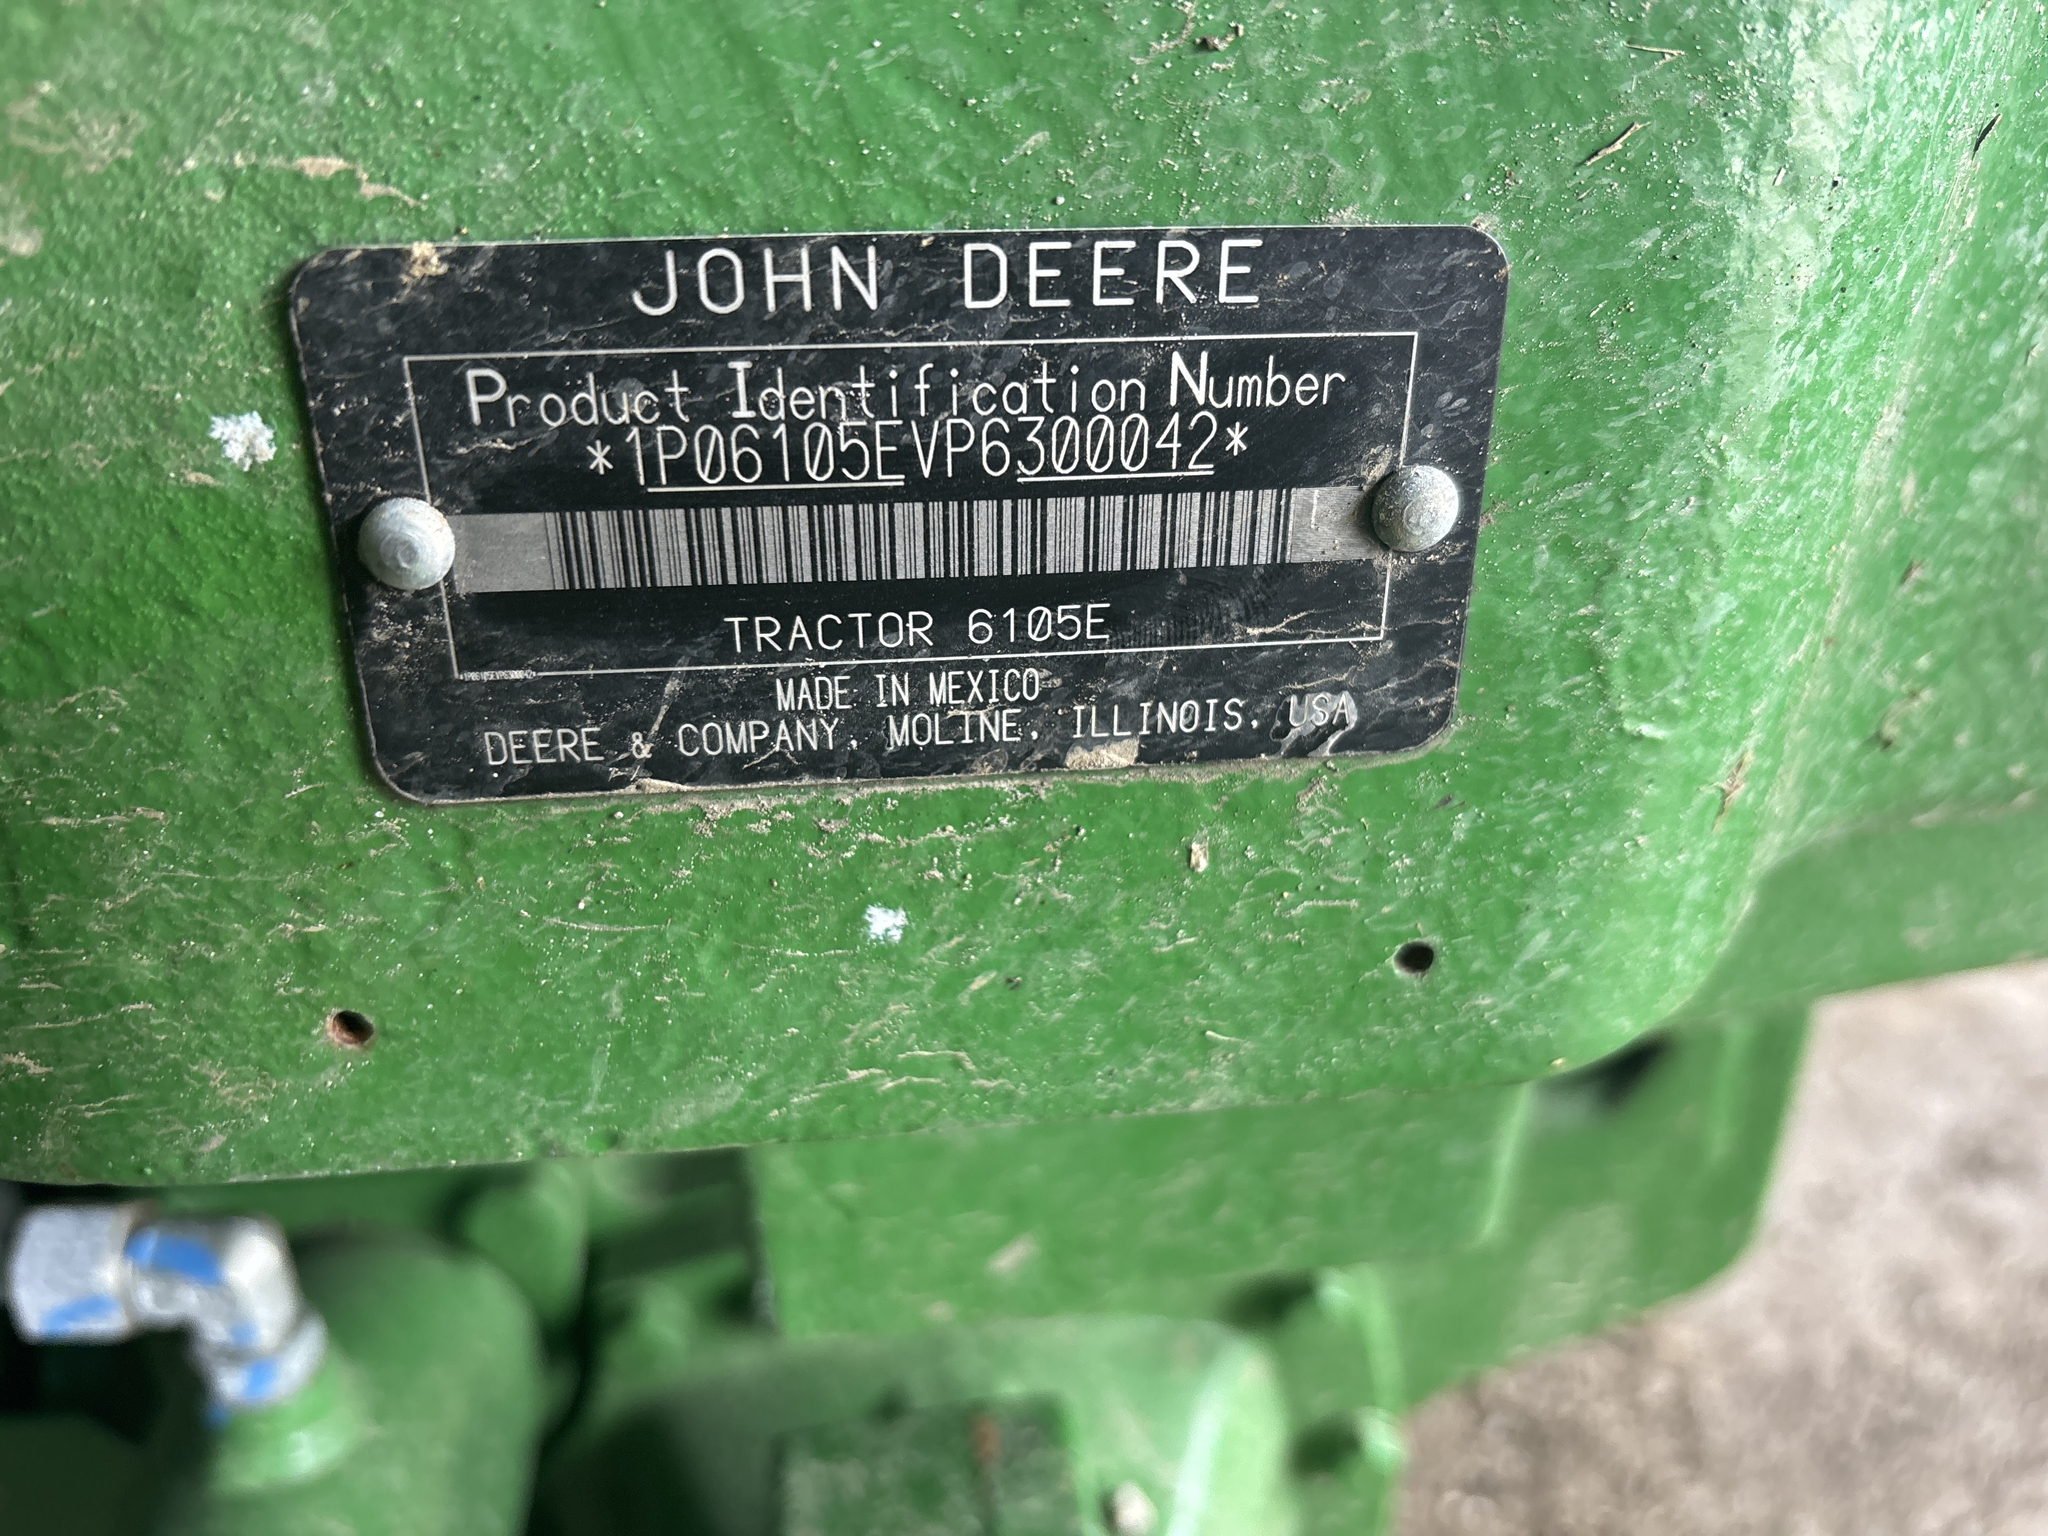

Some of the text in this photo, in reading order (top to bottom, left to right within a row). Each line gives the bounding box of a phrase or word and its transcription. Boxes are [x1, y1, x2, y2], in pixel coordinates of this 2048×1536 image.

[632, 238, 1264, 316] JOHN DEERE
[465, 350, 1346, 428] Product Identification Number
[723, 603, 1111, 654] TRACTOR 6105E
[776, 667, 1040, 712] MADE IN MEXICO
[484, 727, 605, 766] DEERE
[632, 731, 653, 760] &
[1288, 693, 1356, 728] USA
